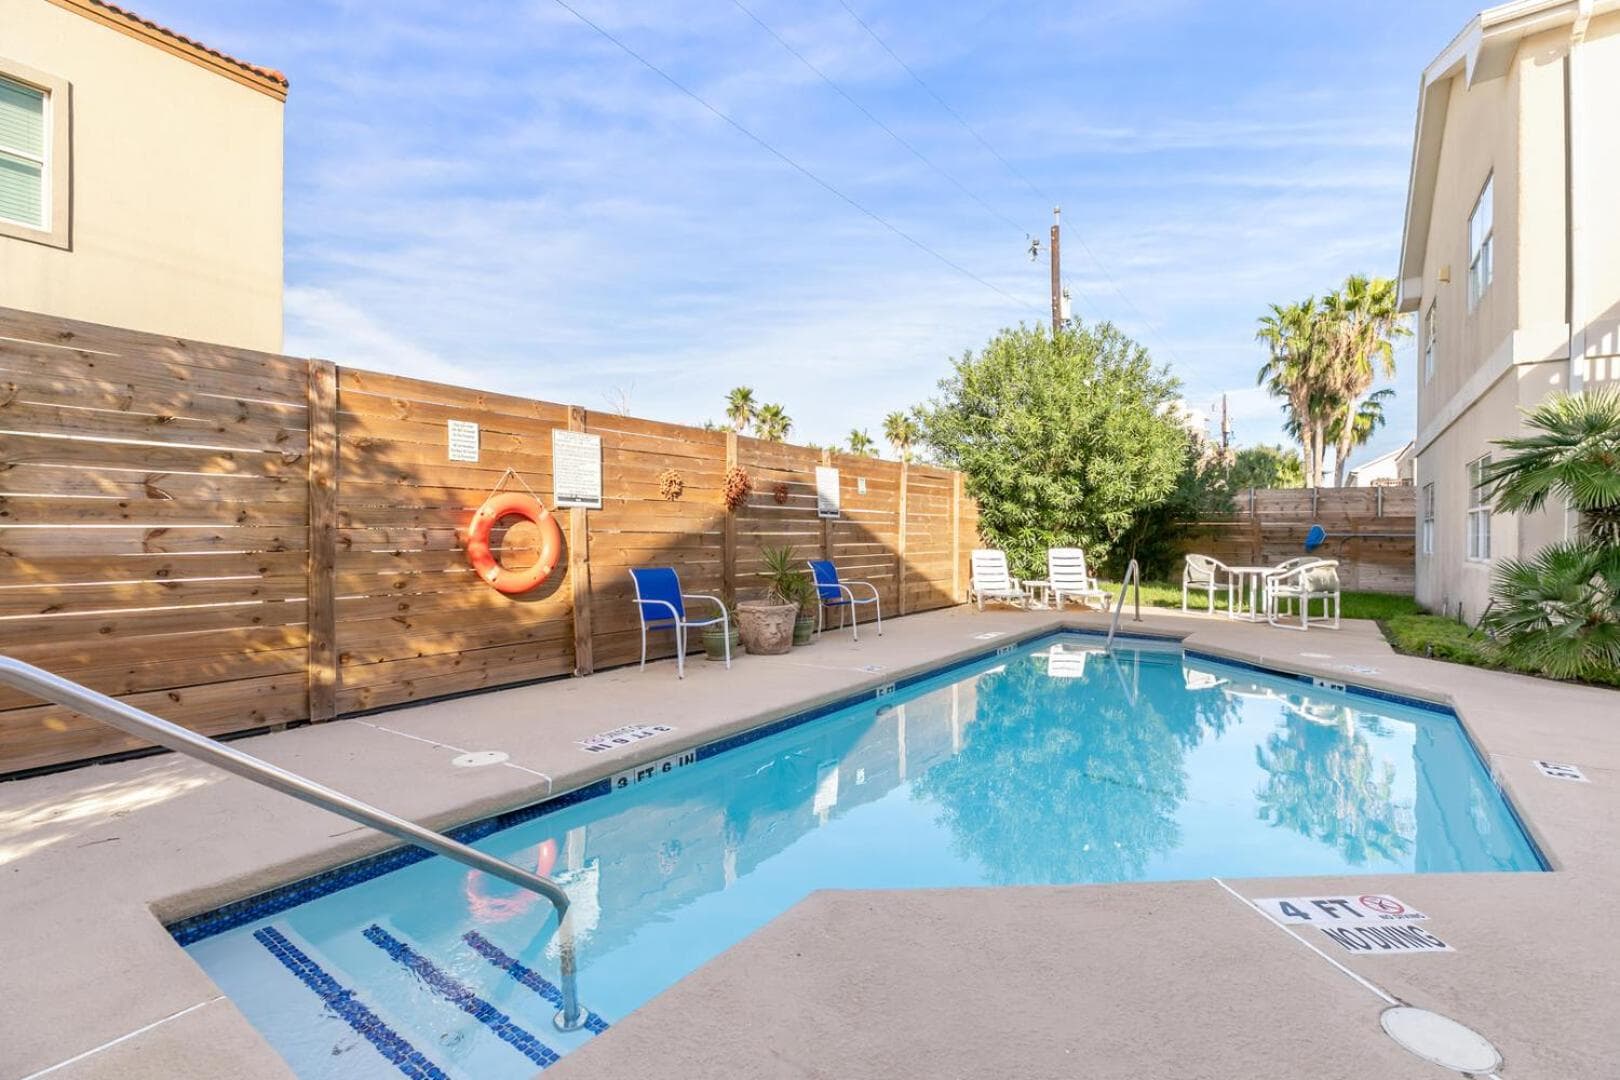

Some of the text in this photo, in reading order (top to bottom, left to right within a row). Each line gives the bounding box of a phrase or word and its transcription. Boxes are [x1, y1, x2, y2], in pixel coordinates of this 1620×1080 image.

[617, 752, 694, 789] 3 FT 6 IN
[1279, 899, 1365, 920] 4 FT
[1320, 925, 1446, 951] NO DIVING
